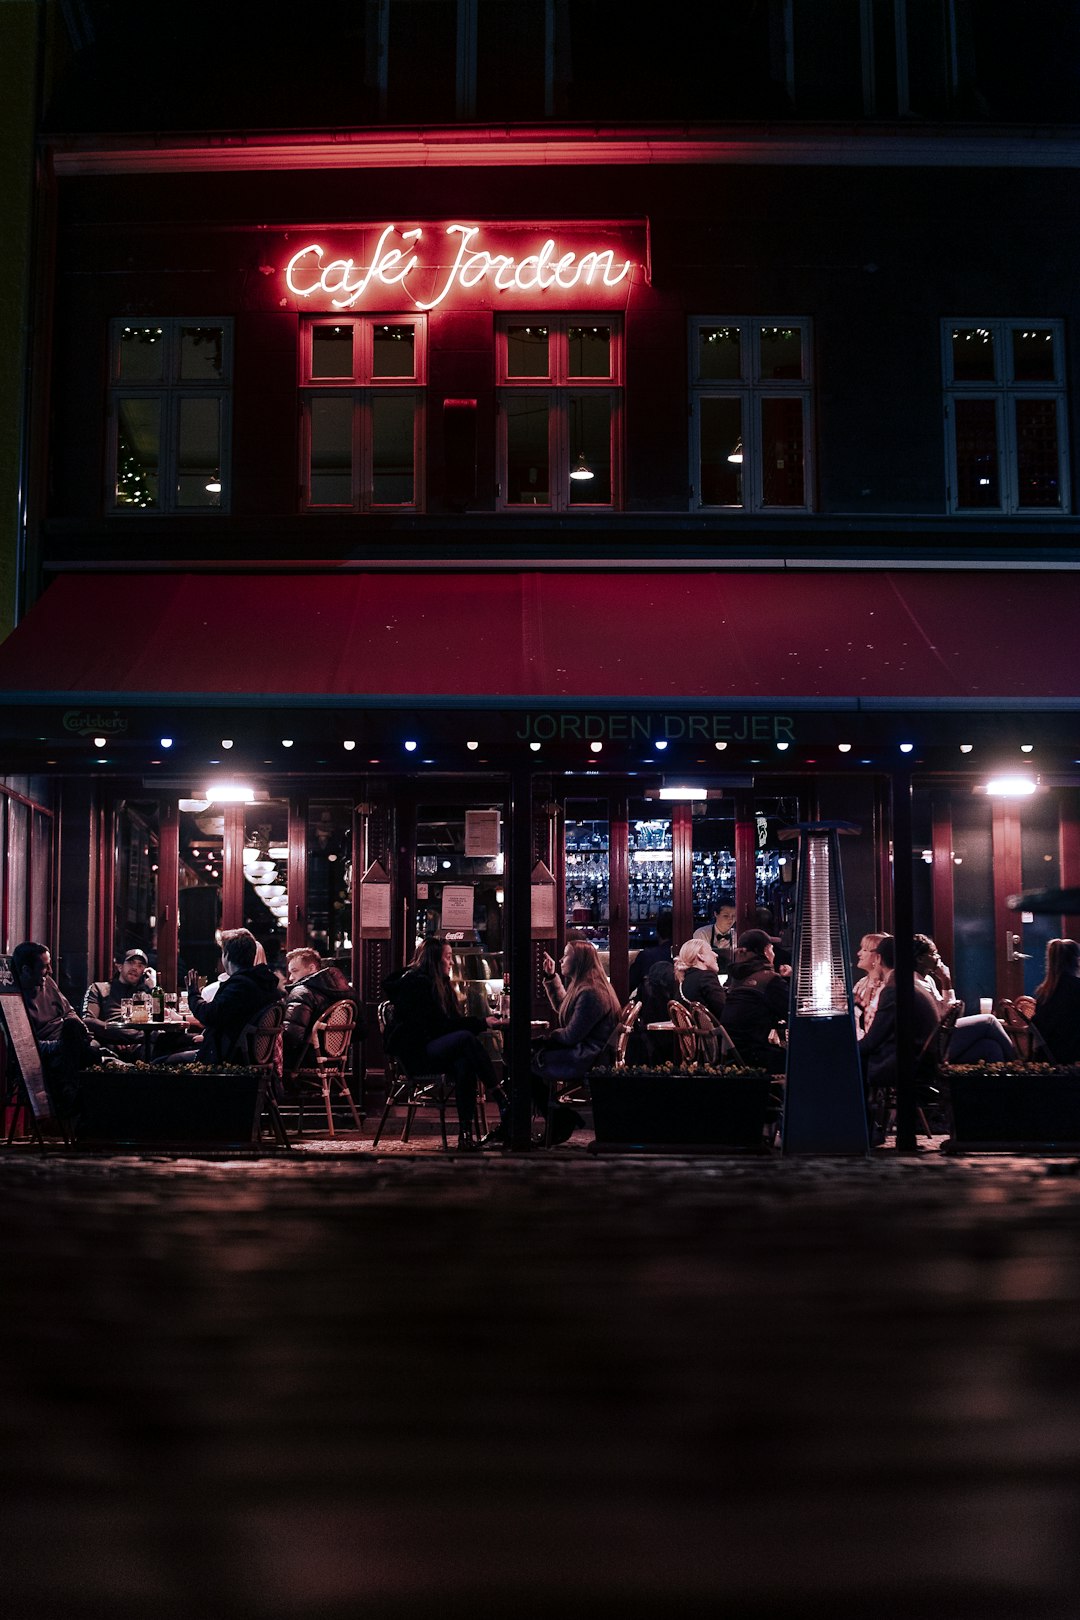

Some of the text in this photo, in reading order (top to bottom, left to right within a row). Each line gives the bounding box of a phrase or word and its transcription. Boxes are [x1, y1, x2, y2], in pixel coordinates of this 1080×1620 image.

[285, 224, 631, 310] Café Jorden
[515, 713, 798, 741] JORDEN DREJER
